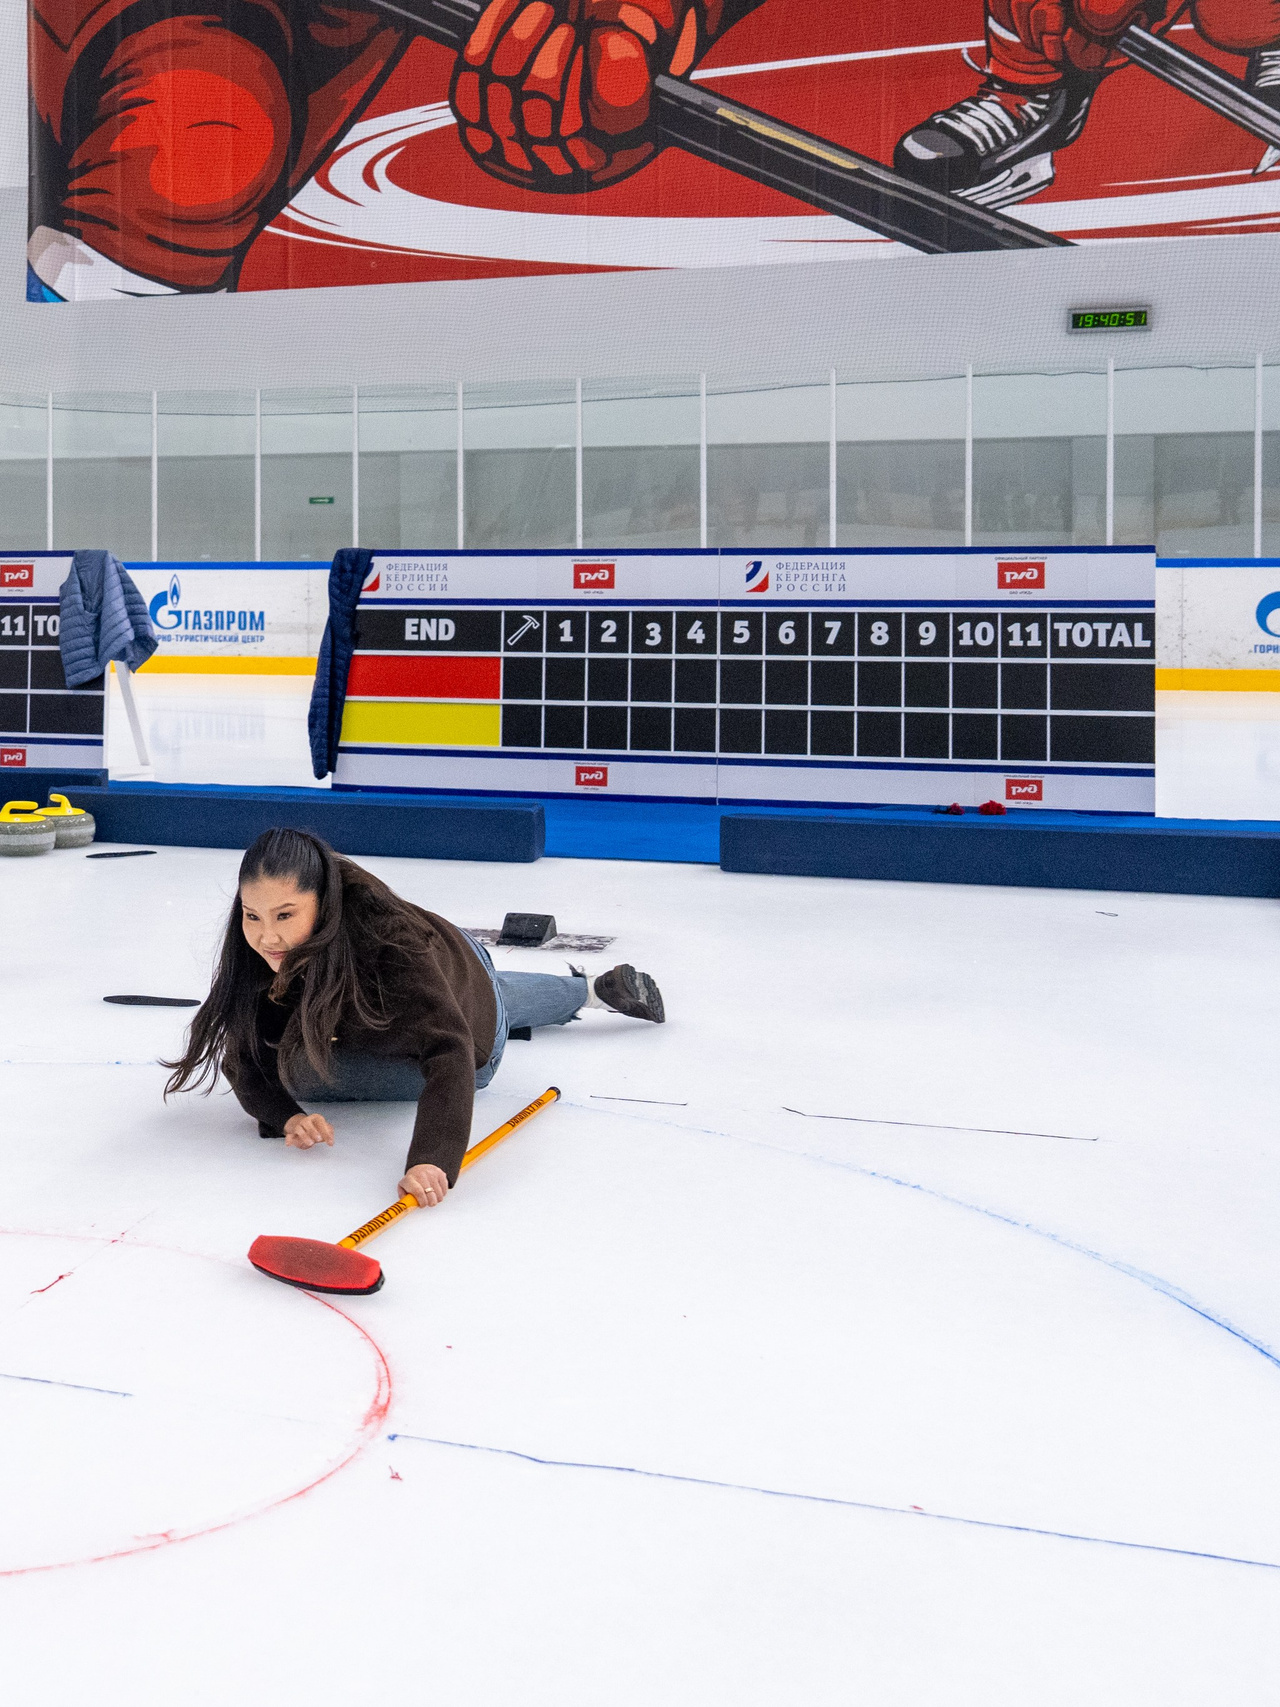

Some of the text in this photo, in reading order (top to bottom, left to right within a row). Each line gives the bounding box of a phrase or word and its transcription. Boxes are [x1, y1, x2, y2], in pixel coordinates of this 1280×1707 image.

[1079, 313, 1146, 327] 19:40:51
[386, 563, 448, 572] ФЕДЕРАЦИЯ
[775, 562, 846, 571] ФЕДЕРАЦИЯ
[386, 583, 448, 591] РОССИИ
[776, 583, 846, 592] РОССИИ
[1, 615, 26, 636] 11
[184, 610, 265, 631] ГАЗПРОМ
[405, 618, 1152, 648] END 1 2 3 4 5 6 7 8 9 10 11 TOTAL
[155, 634, 265, 644] РНО-ТУРИСТИЧЕСКИЙ ЦЕНТР
[1254, 644, 1280, 654] ГОРН
